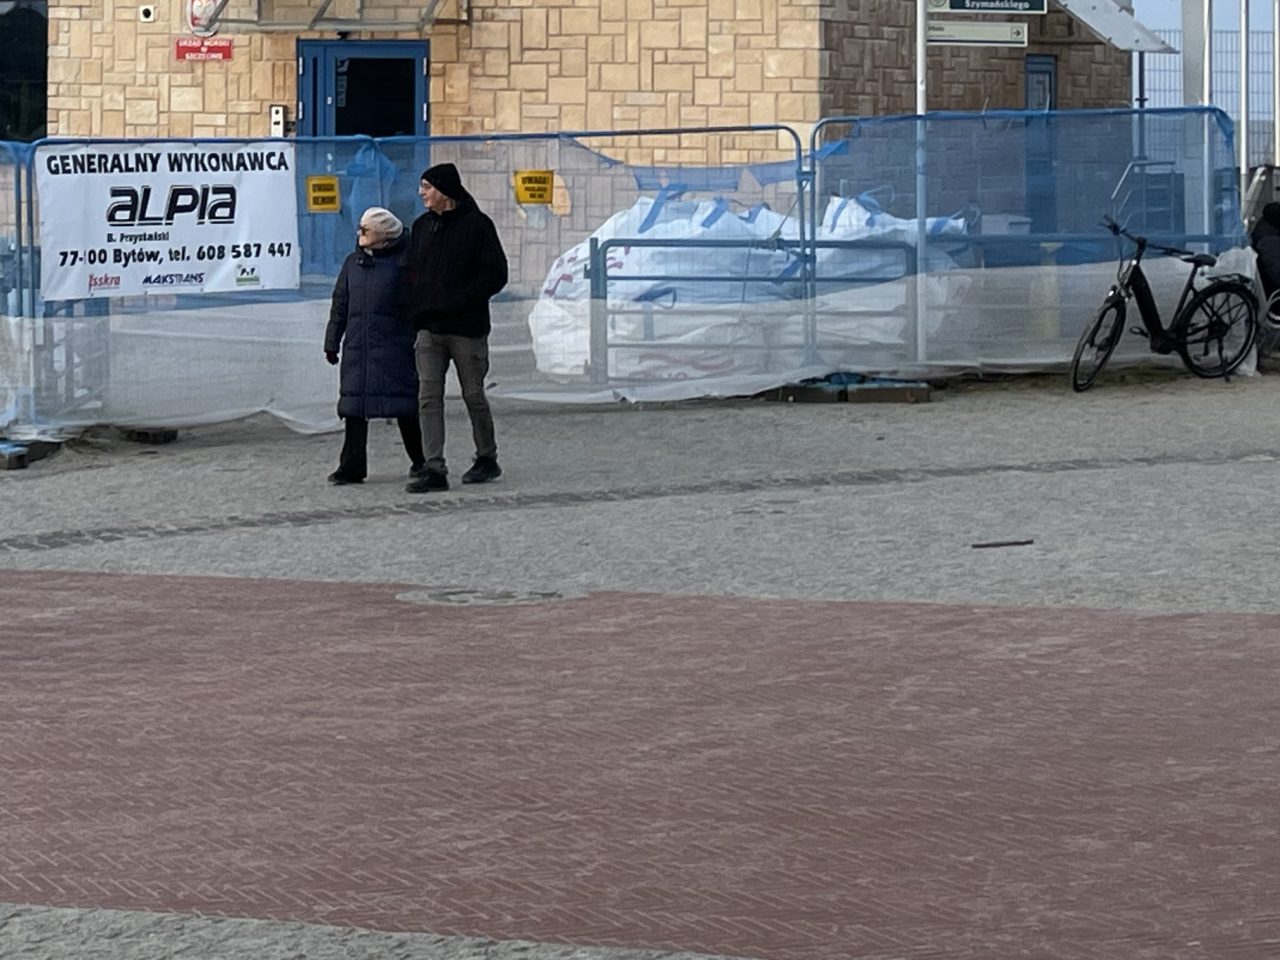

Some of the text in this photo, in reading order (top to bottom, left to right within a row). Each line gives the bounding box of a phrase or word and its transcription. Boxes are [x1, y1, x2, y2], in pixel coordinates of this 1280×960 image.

[46, 151, 289, 175] GENERALNY WYKONAWCA
[112, 247, 164, 268] Bytów,
[168, 245, 191, 261] tel.
[196, 244, 226, 261] 608
[231, 242, 261, 259] 587
[267, 242, 292, 258] 447
